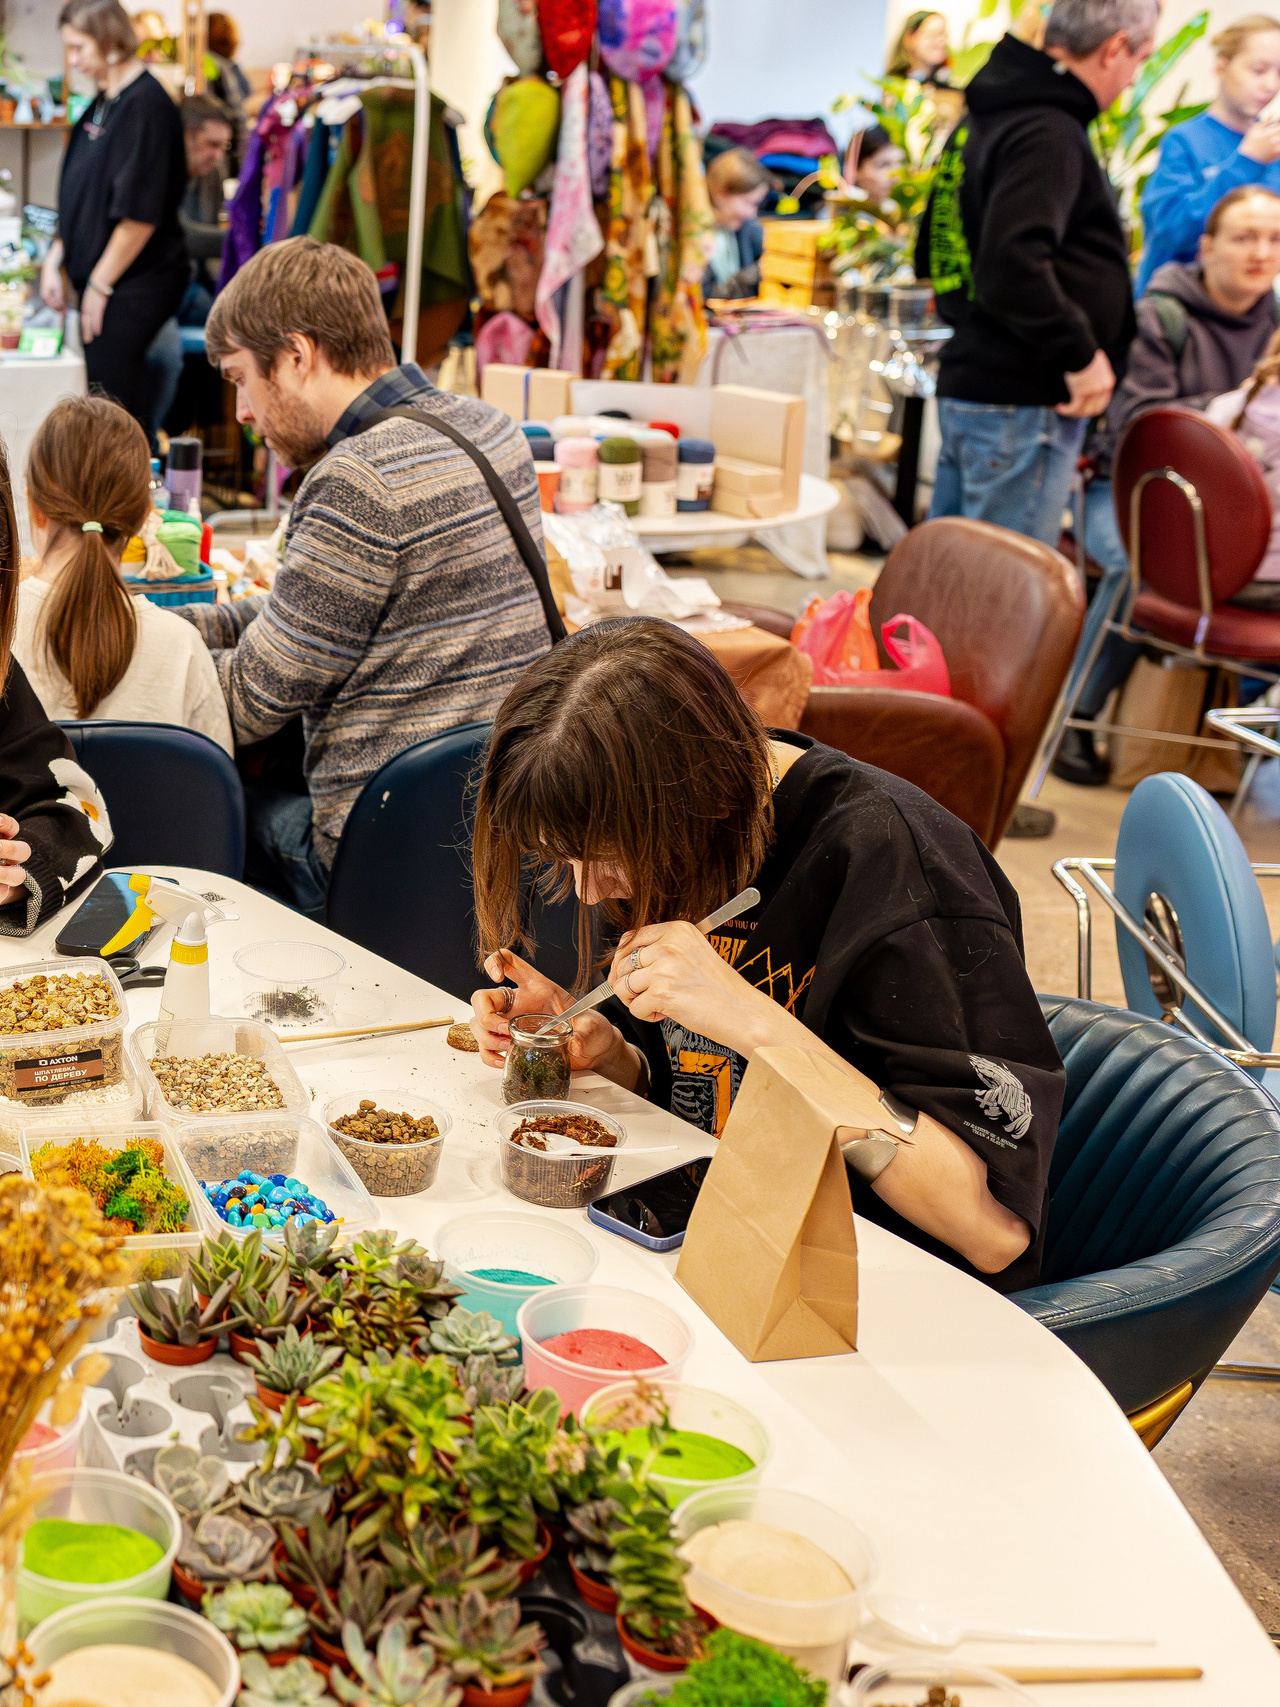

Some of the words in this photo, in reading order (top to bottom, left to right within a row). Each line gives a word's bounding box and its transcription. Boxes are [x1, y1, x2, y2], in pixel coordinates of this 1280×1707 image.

[734, 919, 749, 930] YOU
[750, 921, 758, 931] O
[49, 1055, 78, 1065] AXTON
[34, 1066, 76, 1076] ШПАТЛЕВКА
[51, 1069, 87, 1082] ДЕРЕВУ
